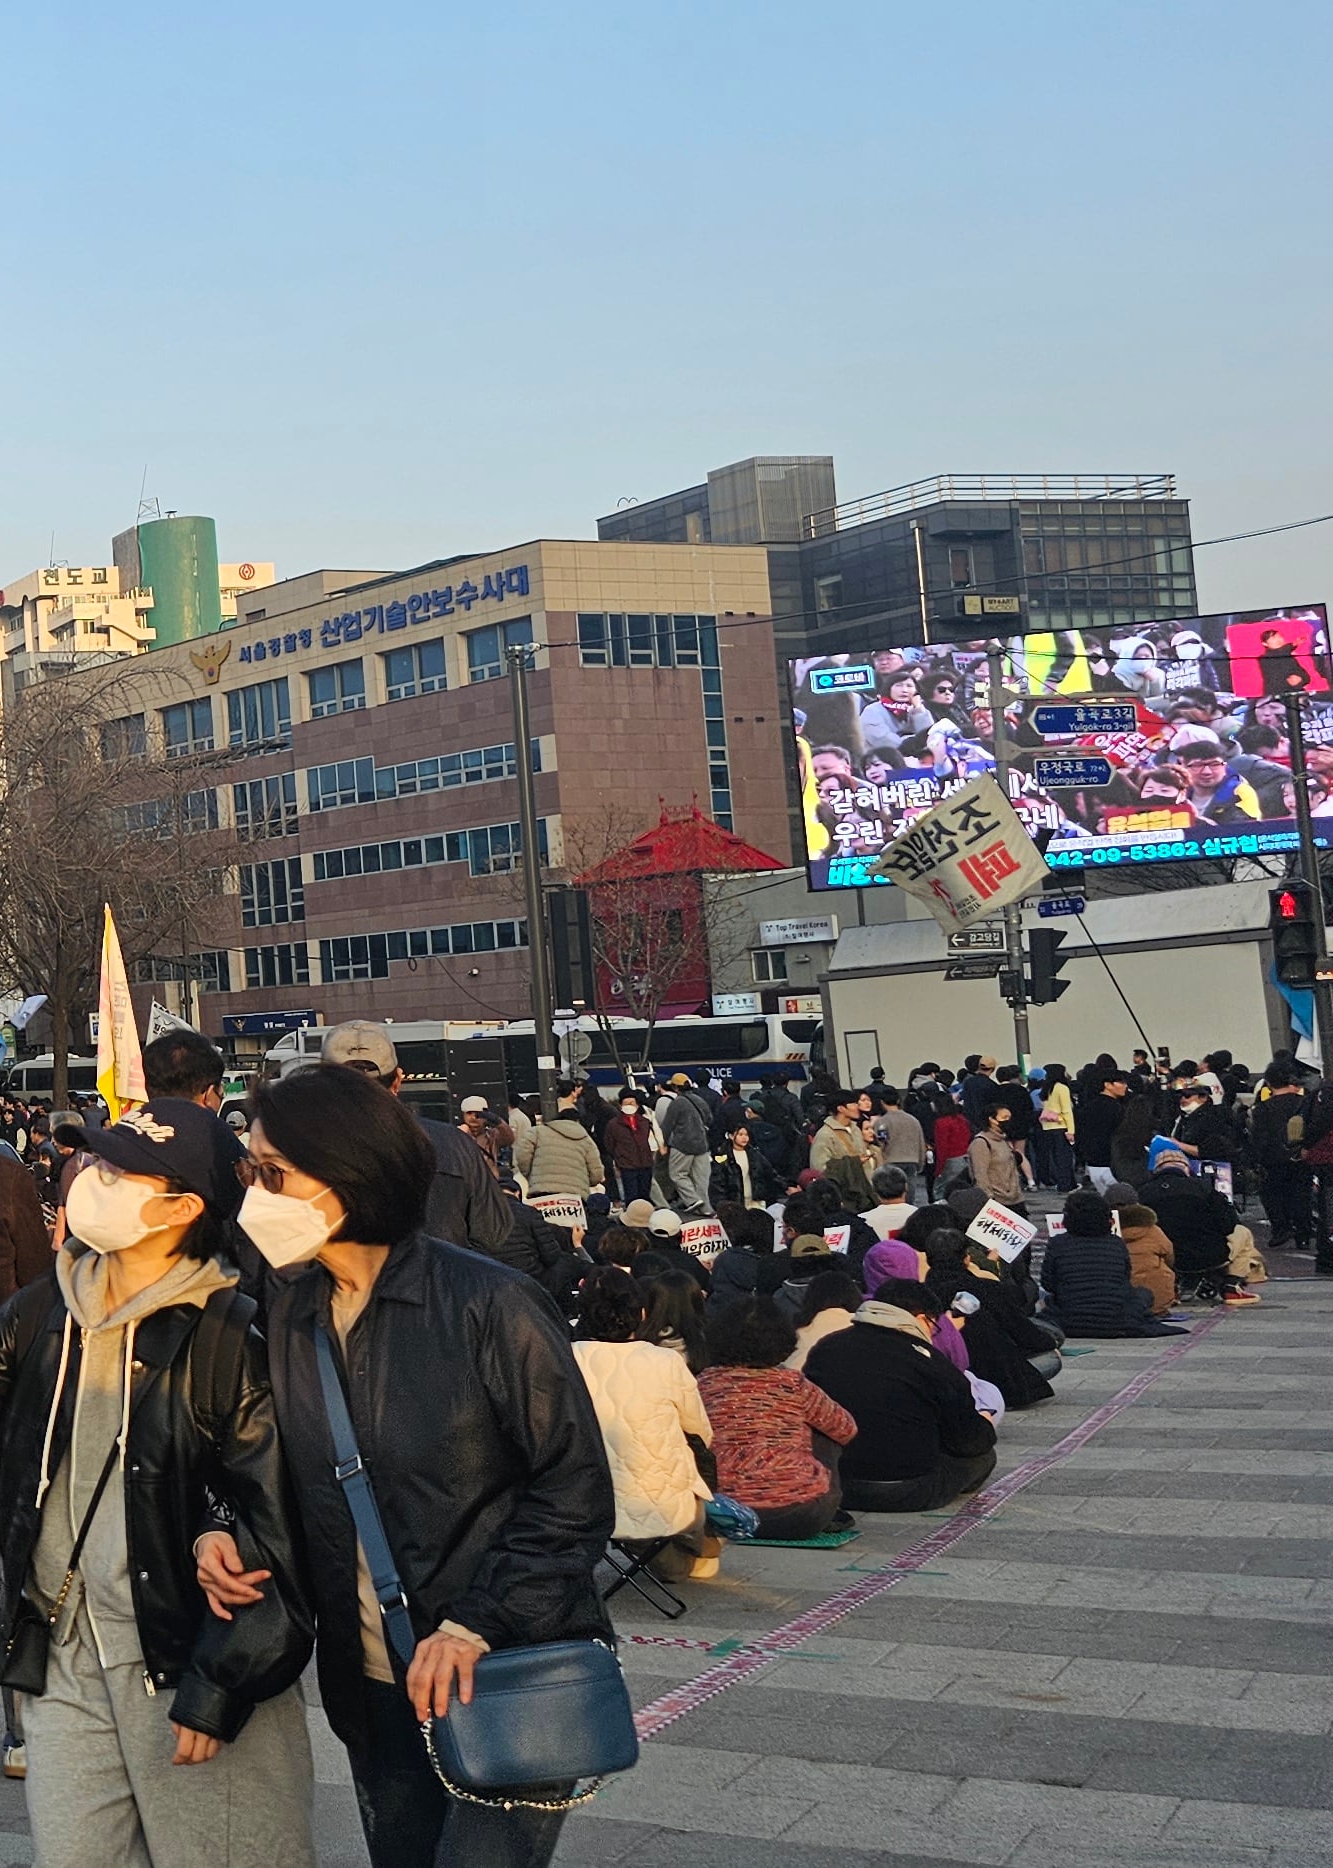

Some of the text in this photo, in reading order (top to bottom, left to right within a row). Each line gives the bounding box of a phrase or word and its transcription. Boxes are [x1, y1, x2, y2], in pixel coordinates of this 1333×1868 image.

[43, 567, 108, 586] 천도교
[238, 564, 530, 664] 서울경찰청 산업기술안보수사대
[1074, 708, 1133, 722] 율곡로3길
[1069, 723, 1134, 732] Yulgok-ro 3-gil
[1039, 761, 1086, 774] 우정국로
[1039, 776, 1099, 785] Ujeongguk-ro
[829, 782, 933, 815] 갇혀버린
[832, 819, 884, 848] 우린
[788, 922, 808, 930] Travel
[540, 1206, 583, 1218] 체하라!
